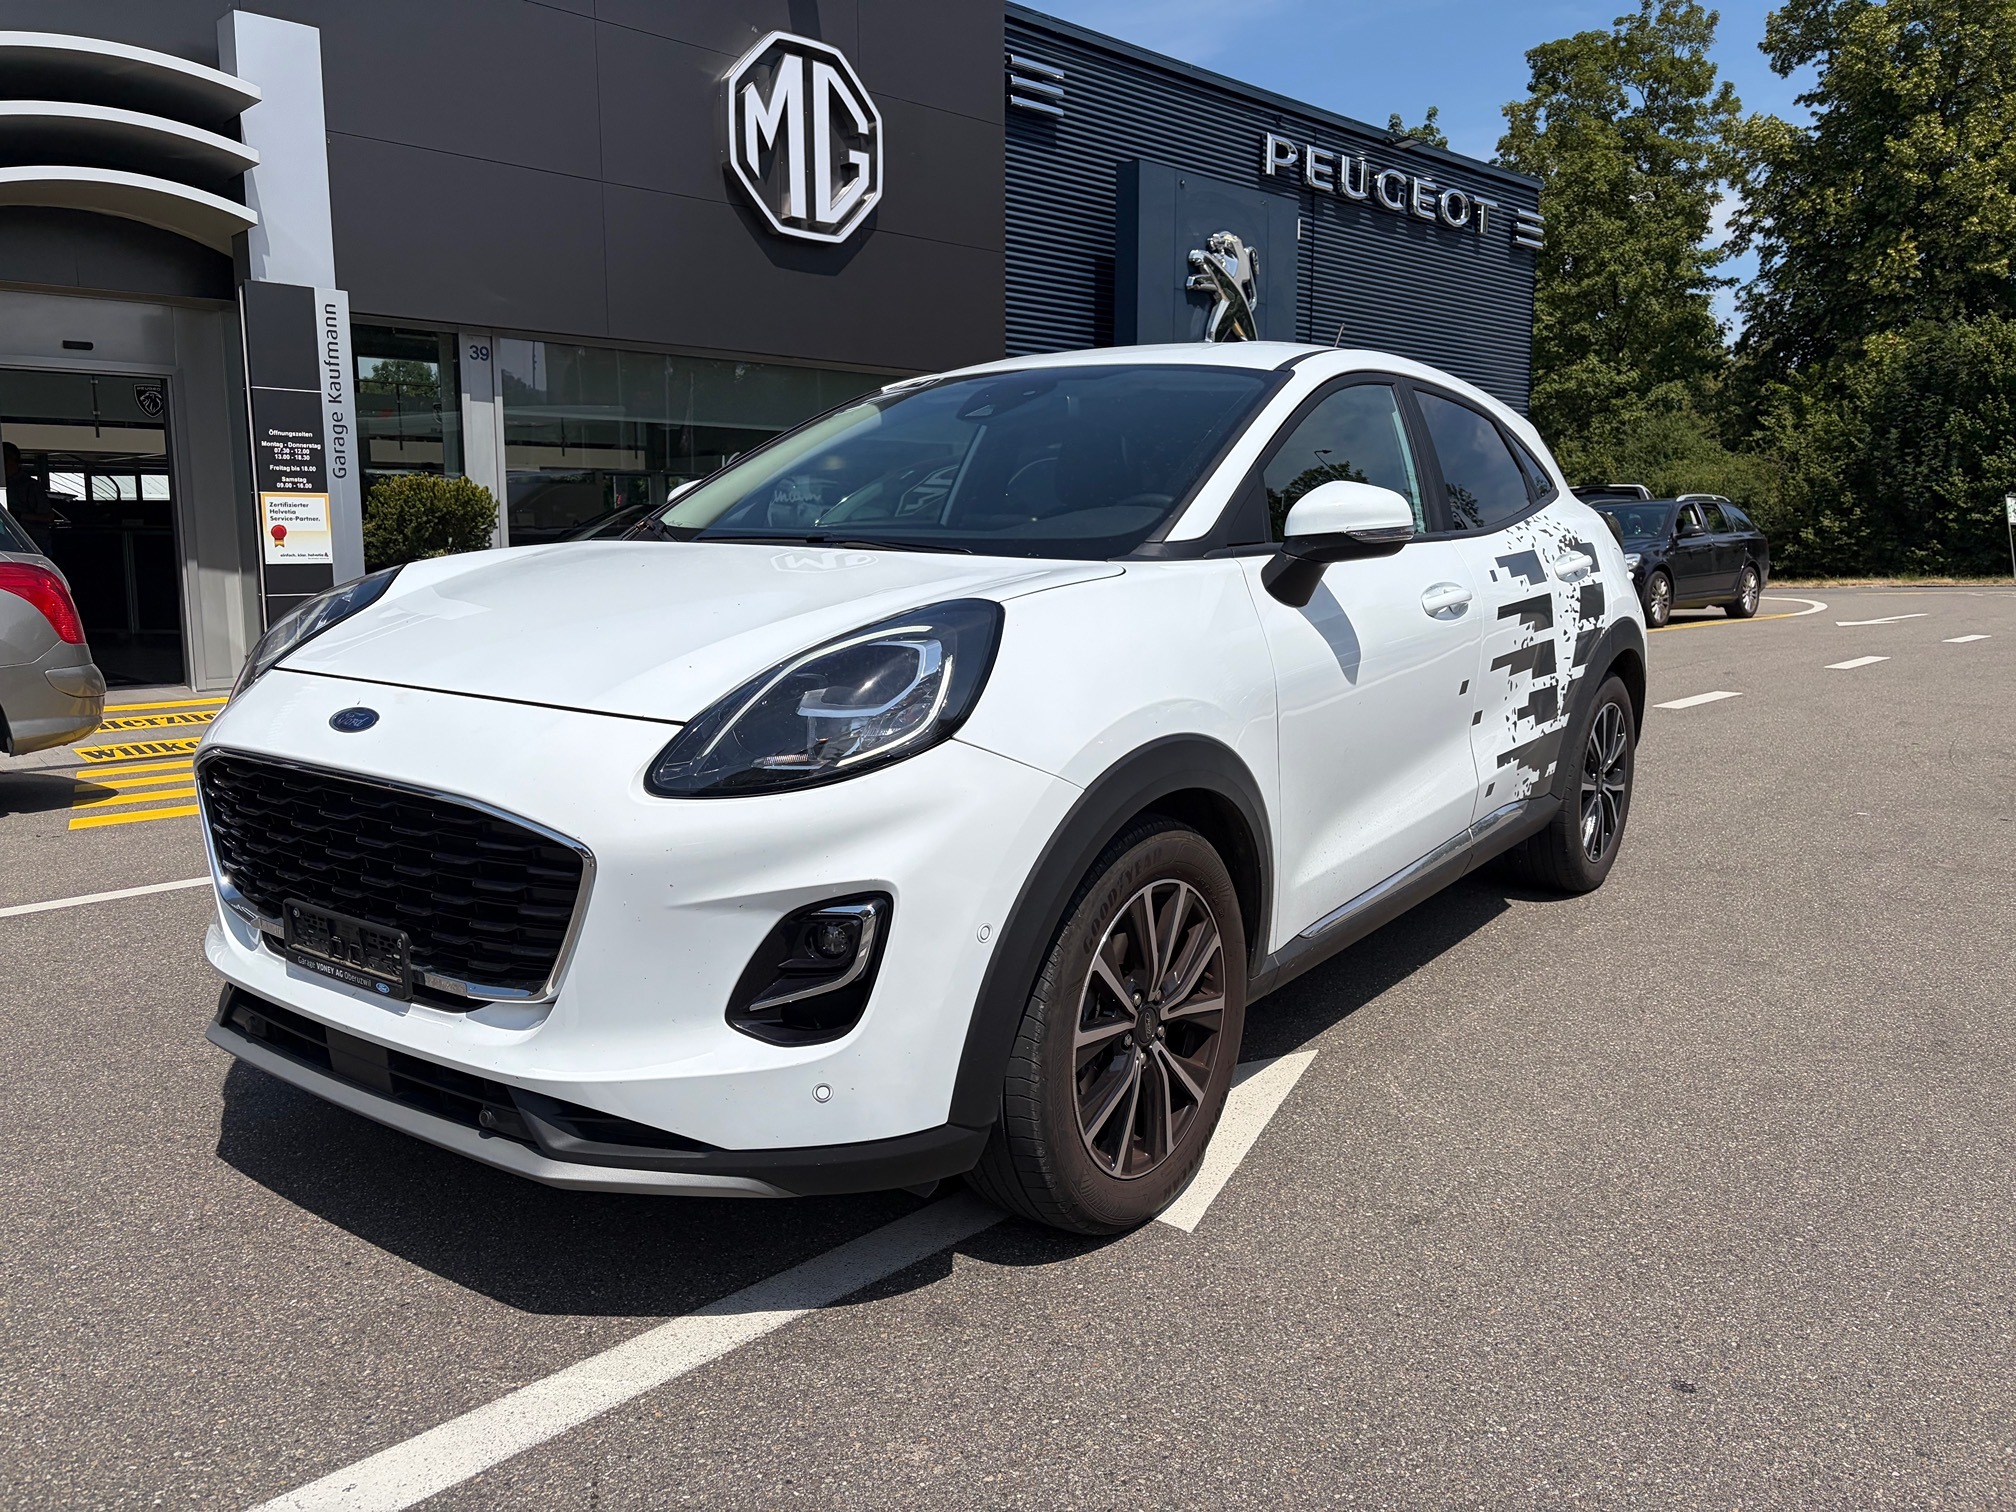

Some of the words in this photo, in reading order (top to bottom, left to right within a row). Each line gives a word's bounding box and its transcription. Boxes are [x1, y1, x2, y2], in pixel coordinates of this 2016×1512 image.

[745, 53, 870, 223] MG
[1264, 131, 1498, 235] PEUGEOT
[323, 303, 342, 404] Kaufmann
[469, 344, 490, 361] 39
[268, 429, 313, 438] Öffnungszeiten
[288, 442, 321, 450] Donnerstag
[332, 411, 348, 479] Garage
[281, 476, 307, 484] Samstag
[1082, 847, 1163, 955] GOODYEAR
[298, 956, 316, 969] Garage
[335, 968, 344, 978] AG
